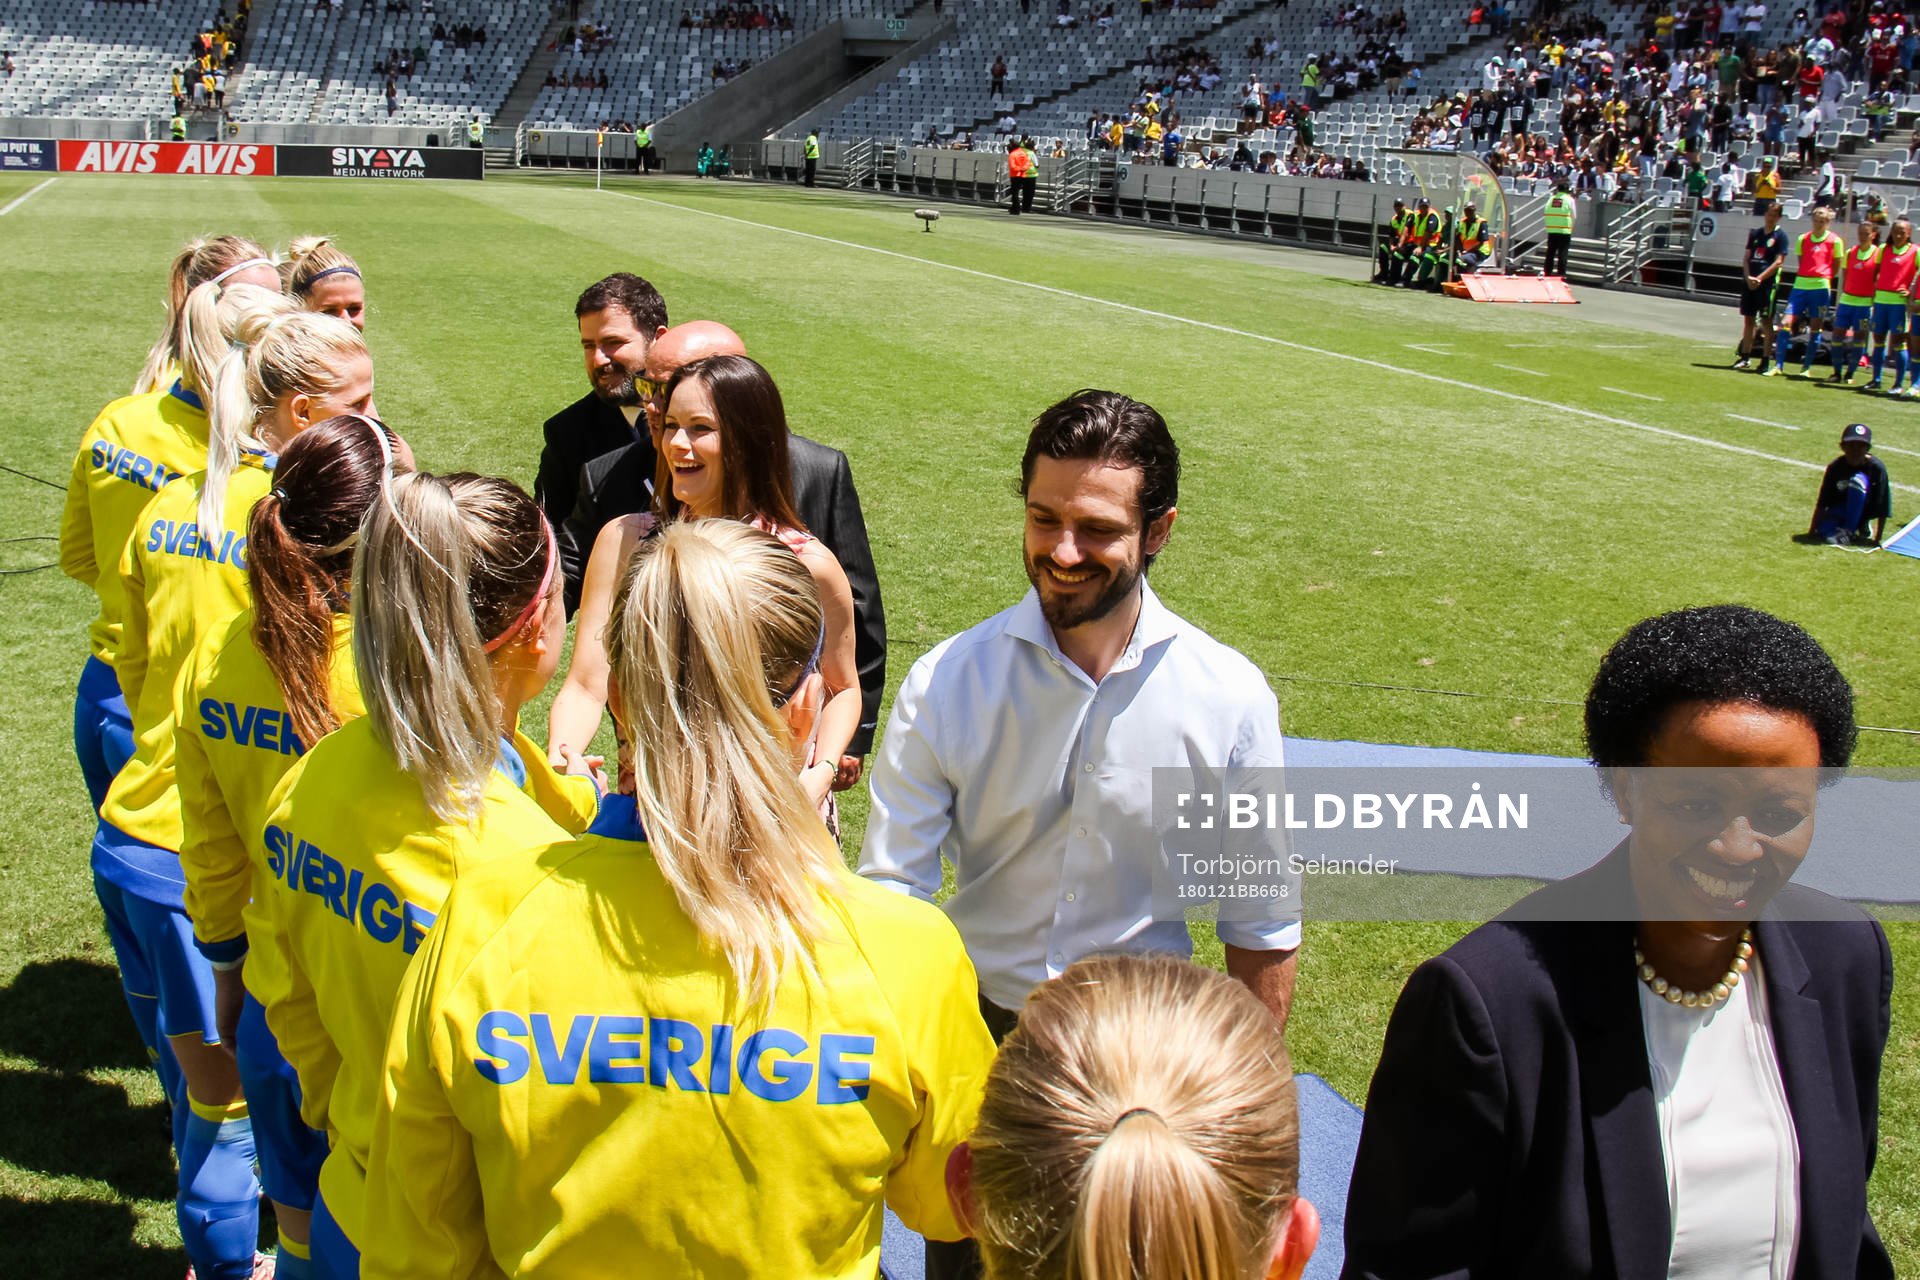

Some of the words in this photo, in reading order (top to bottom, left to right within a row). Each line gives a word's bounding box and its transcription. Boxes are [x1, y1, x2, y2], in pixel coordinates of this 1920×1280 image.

[9, 142, 28, 153] PUT
[75, 142, 160, 173] AVIS
[176, 144, 259, 175] AVIS
[332, 147, 426, 168] SIYAYA
[333, 168, 368, 177] MEDIA
[370, 169, 425, 178] NETWORK
[264, 825, 438, 956] SVERIGE
[474, 1009, 876, 1105] SVERIGE
